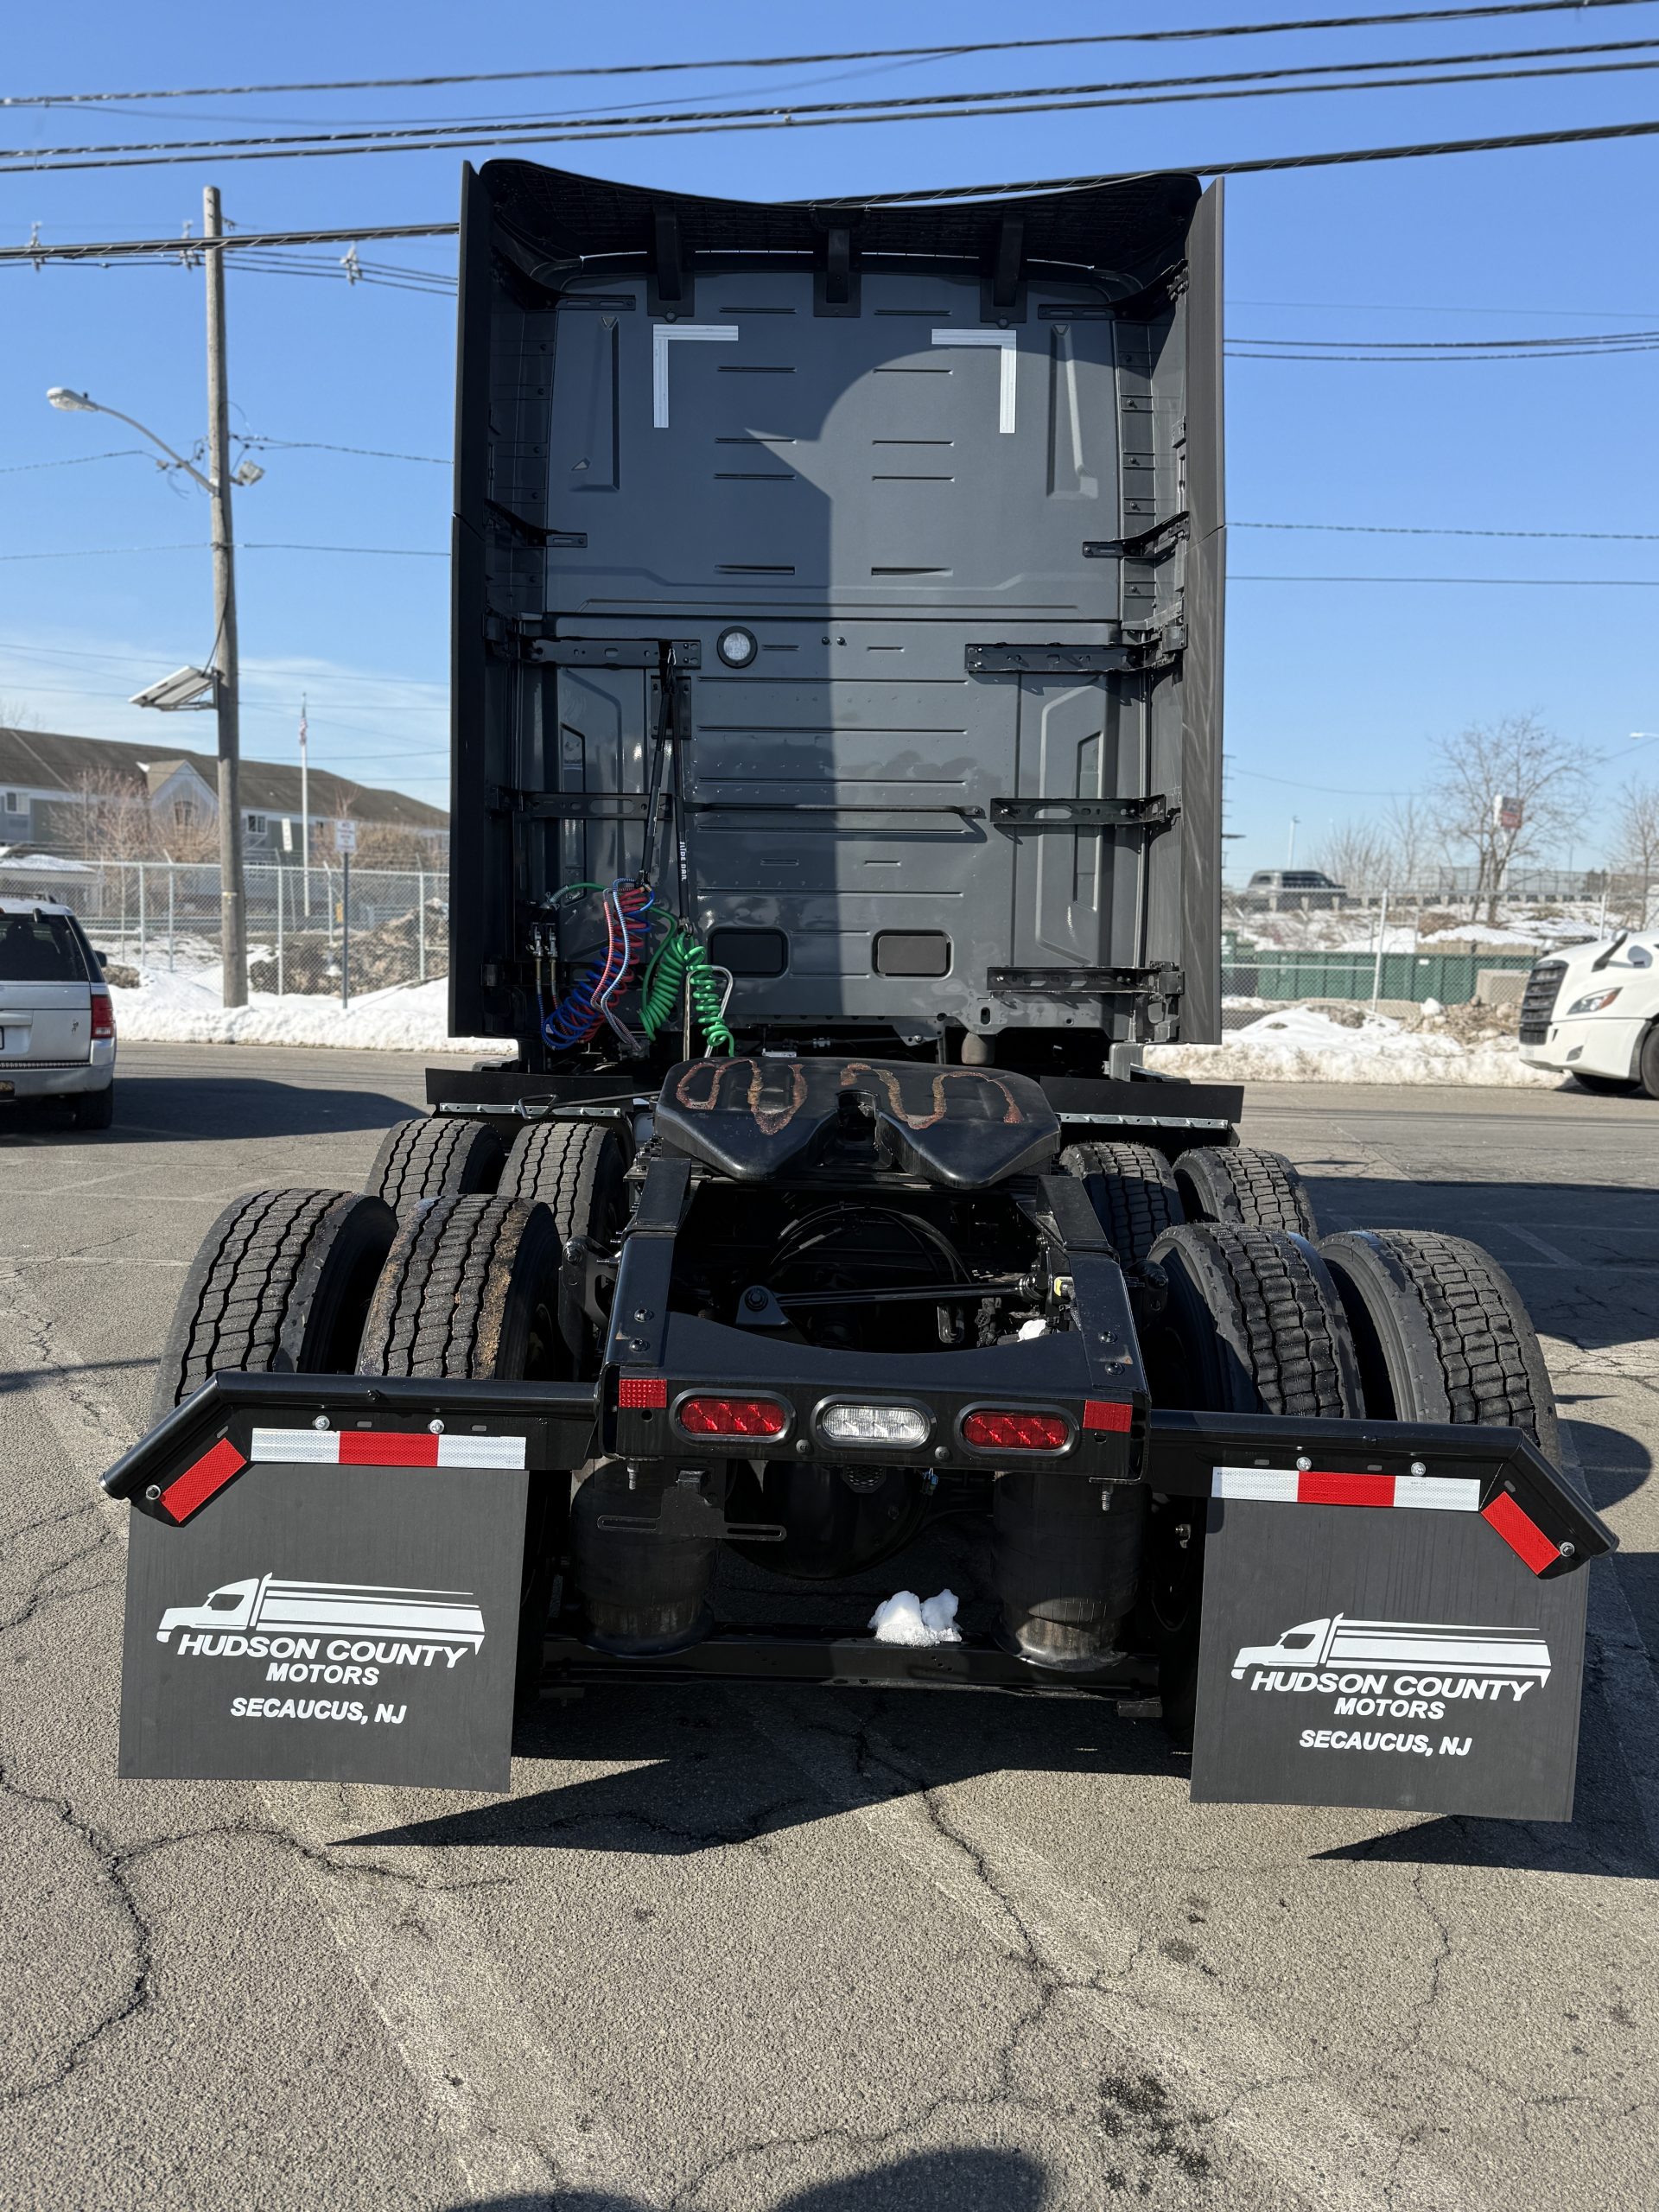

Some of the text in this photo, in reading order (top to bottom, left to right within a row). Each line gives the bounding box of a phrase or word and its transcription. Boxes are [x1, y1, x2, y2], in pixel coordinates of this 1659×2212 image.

[176, 1633, 469, 1669] HUDSON COUNTY
[265, 1662, 380, 1687] MOTORS
[1250, 1670, 1535, 1702] HUDSON COUNTY
[230, 1697, 408, 1726] SECAUCUS, NJ
[1333, 1697, 1446, 1720] MOTORS
[1299, 1729, 1473, 1758] SECAUCUS, NJ
